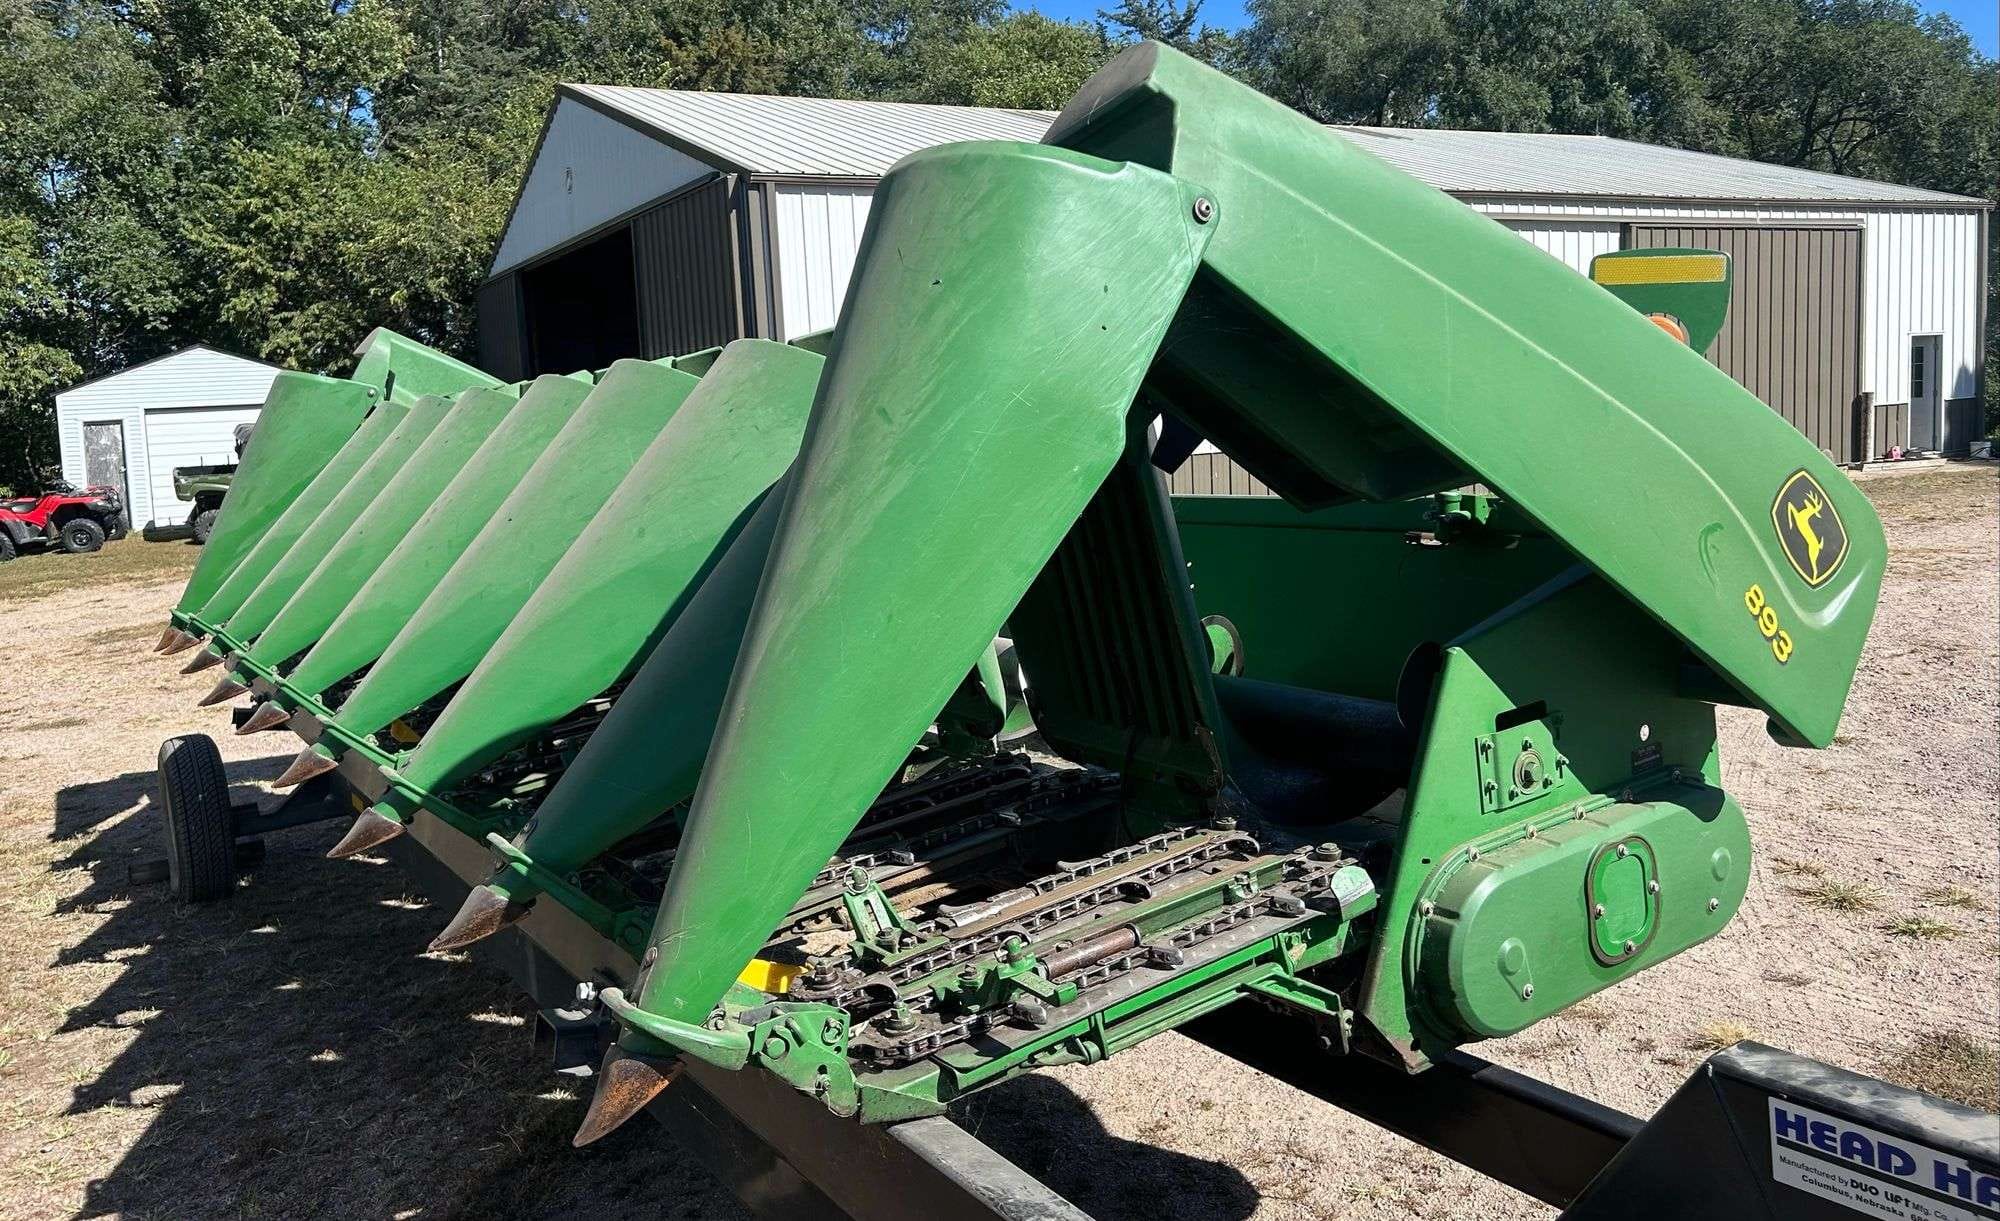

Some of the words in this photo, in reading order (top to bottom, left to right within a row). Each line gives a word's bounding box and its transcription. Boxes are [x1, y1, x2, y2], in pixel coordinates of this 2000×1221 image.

[1744, 583, 1793, 662] 893
[1774, 1107, 1916, 1176] HEAD
[1779, 1155, 1836, 1181] Manufactured
[1838, 1176, 1848, 1187] by
[1850, 1178, 1879, 1196] DUO
[1801, 1174, 1853, 1199] Columbus,
[1855, 1194, 1904, 1217] Nebraska
